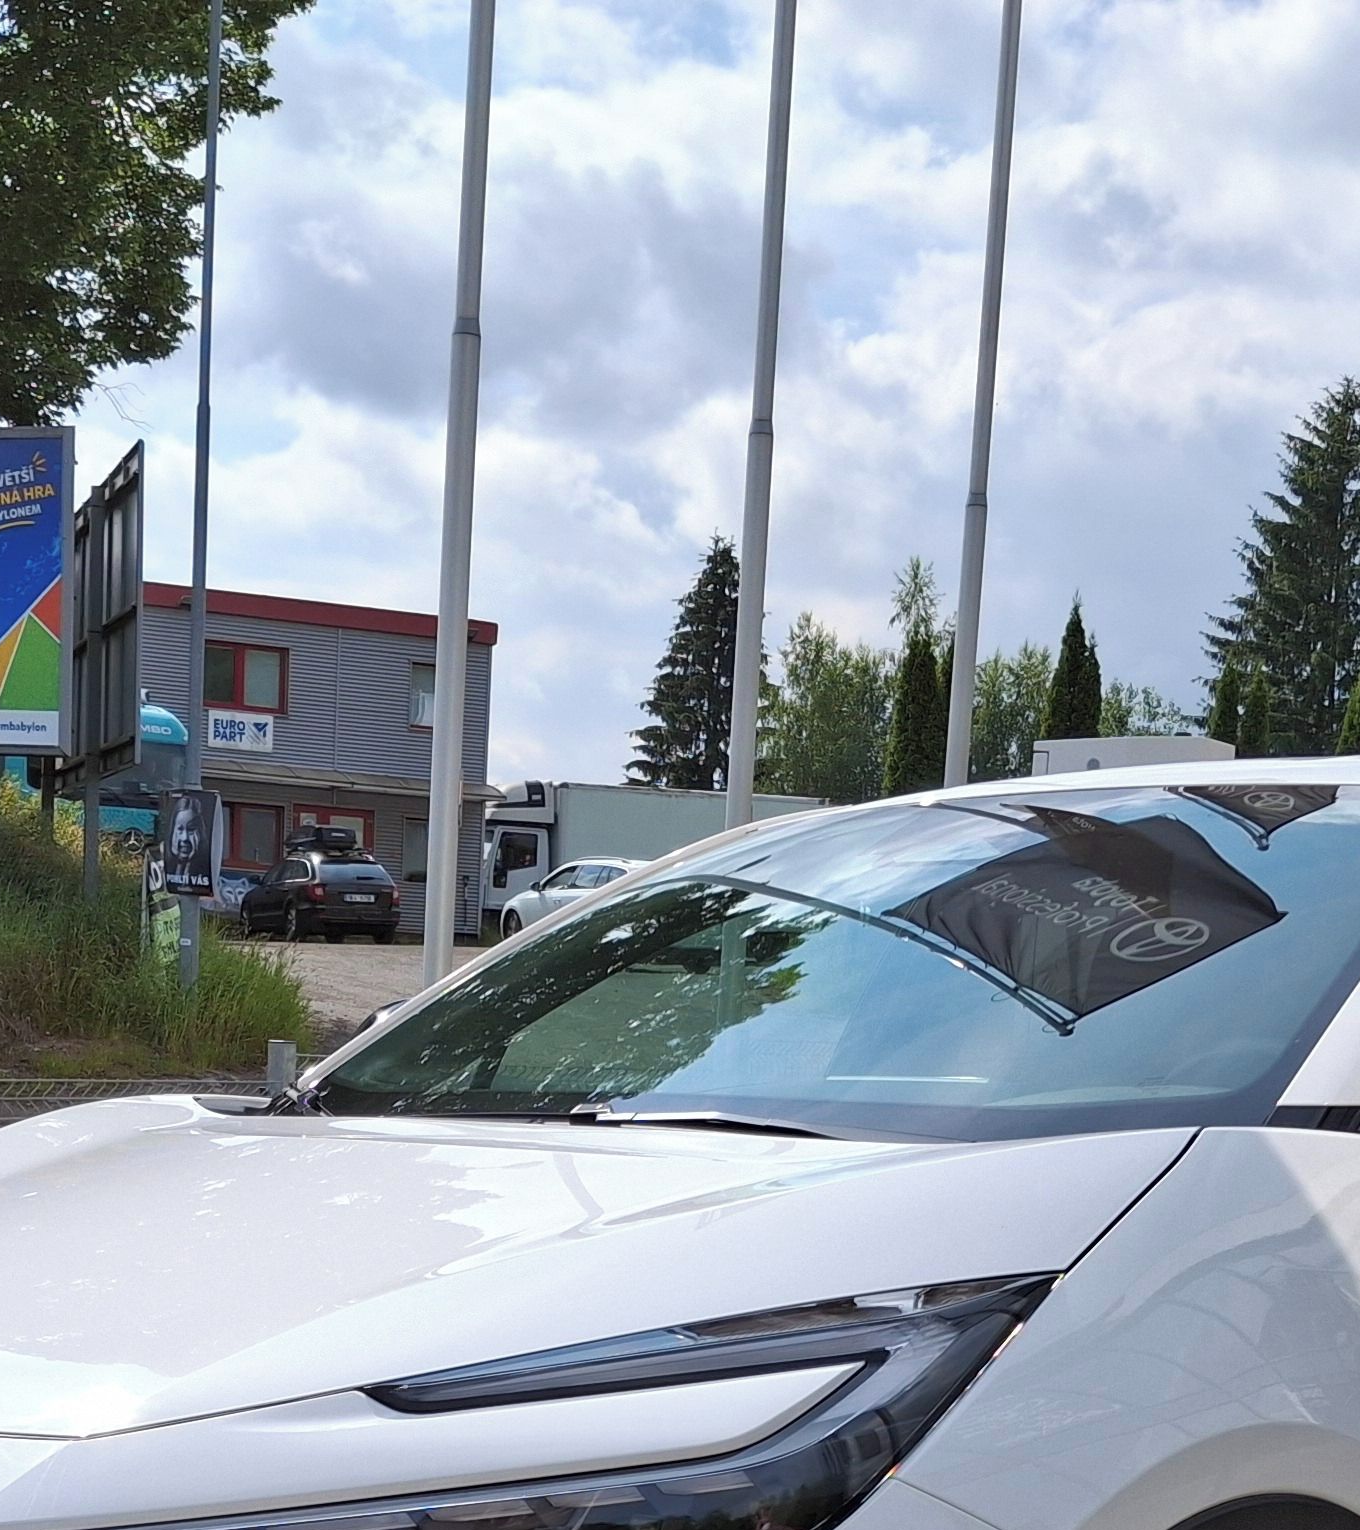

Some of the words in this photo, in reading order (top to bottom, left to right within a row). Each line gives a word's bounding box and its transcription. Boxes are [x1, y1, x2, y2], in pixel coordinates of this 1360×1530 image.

[24, 483, 55, 500] HRA
[140, 724, 172, 735] MBO
[213, 718, 246, 732] EURO
[213, 730, 246, 743] PART
